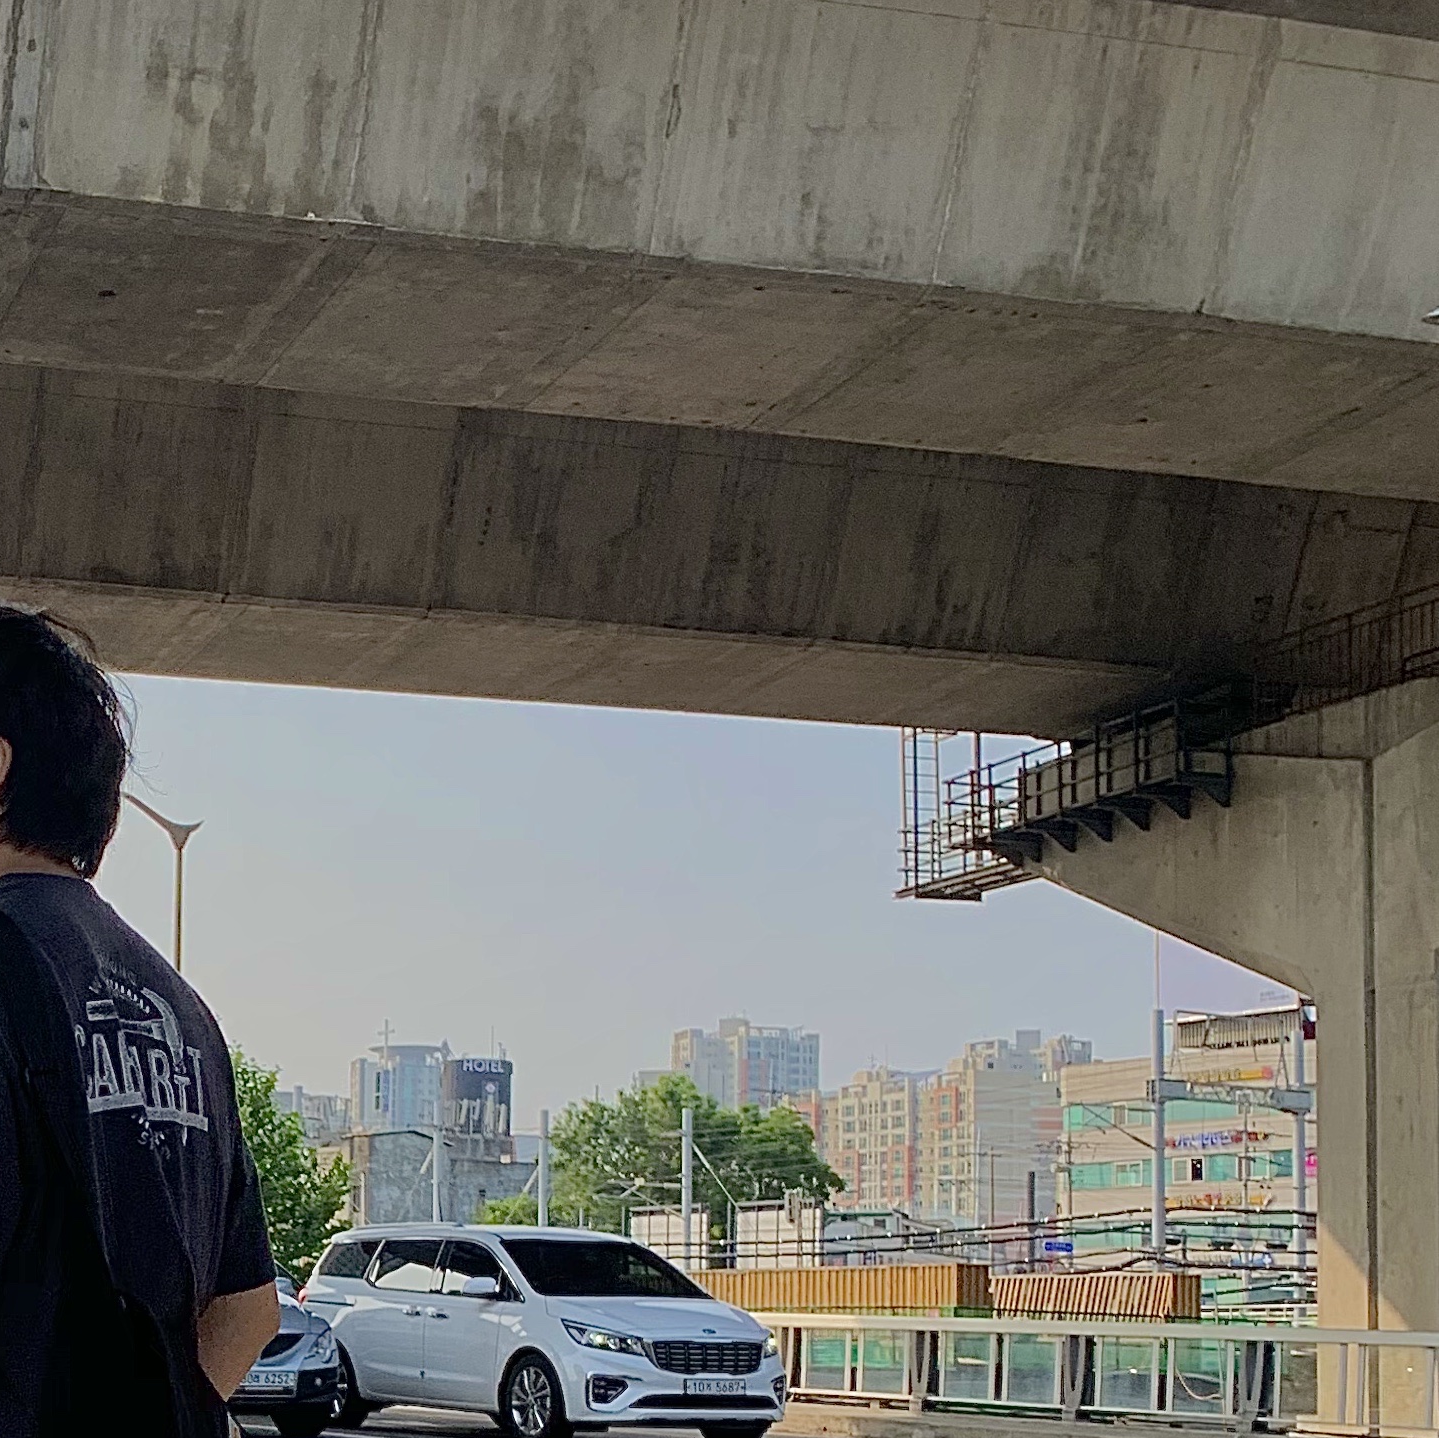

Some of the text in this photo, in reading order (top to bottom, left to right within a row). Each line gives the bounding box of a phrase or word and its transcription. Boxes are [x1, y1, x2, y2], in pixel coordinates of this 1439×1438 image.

[462, 1059, 504, 1073] HOTEL
[264, 1373, 290, 1384] 6252
[716, 1381, 740, 1393] 5687
